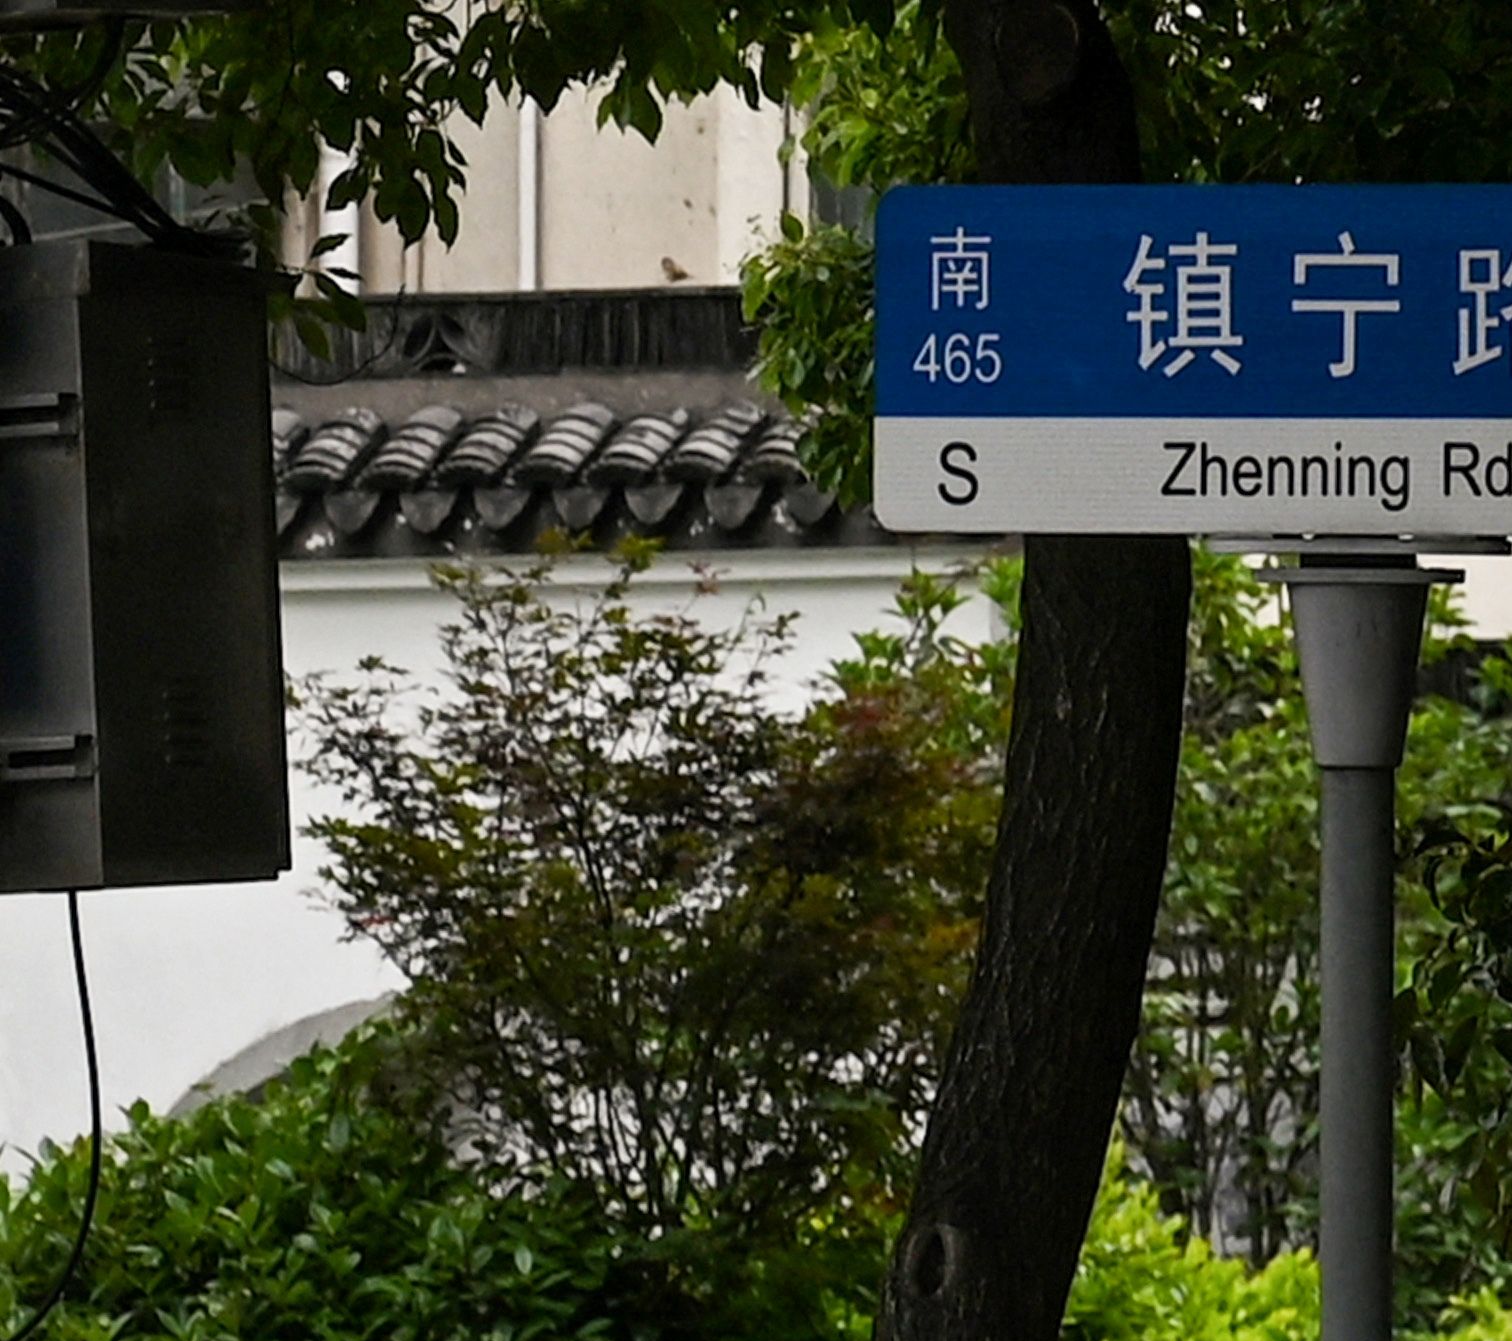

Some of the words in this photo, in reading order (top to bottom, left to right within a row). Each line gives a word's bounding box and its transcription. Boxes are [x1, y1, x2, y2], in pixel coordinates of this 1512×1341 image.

[928, 226, 993, 312] 南
[912, 333, 1002, 385] 465
[936, 440, 981, 507] S
[1160, 439, 1411, 511] Zhenning
